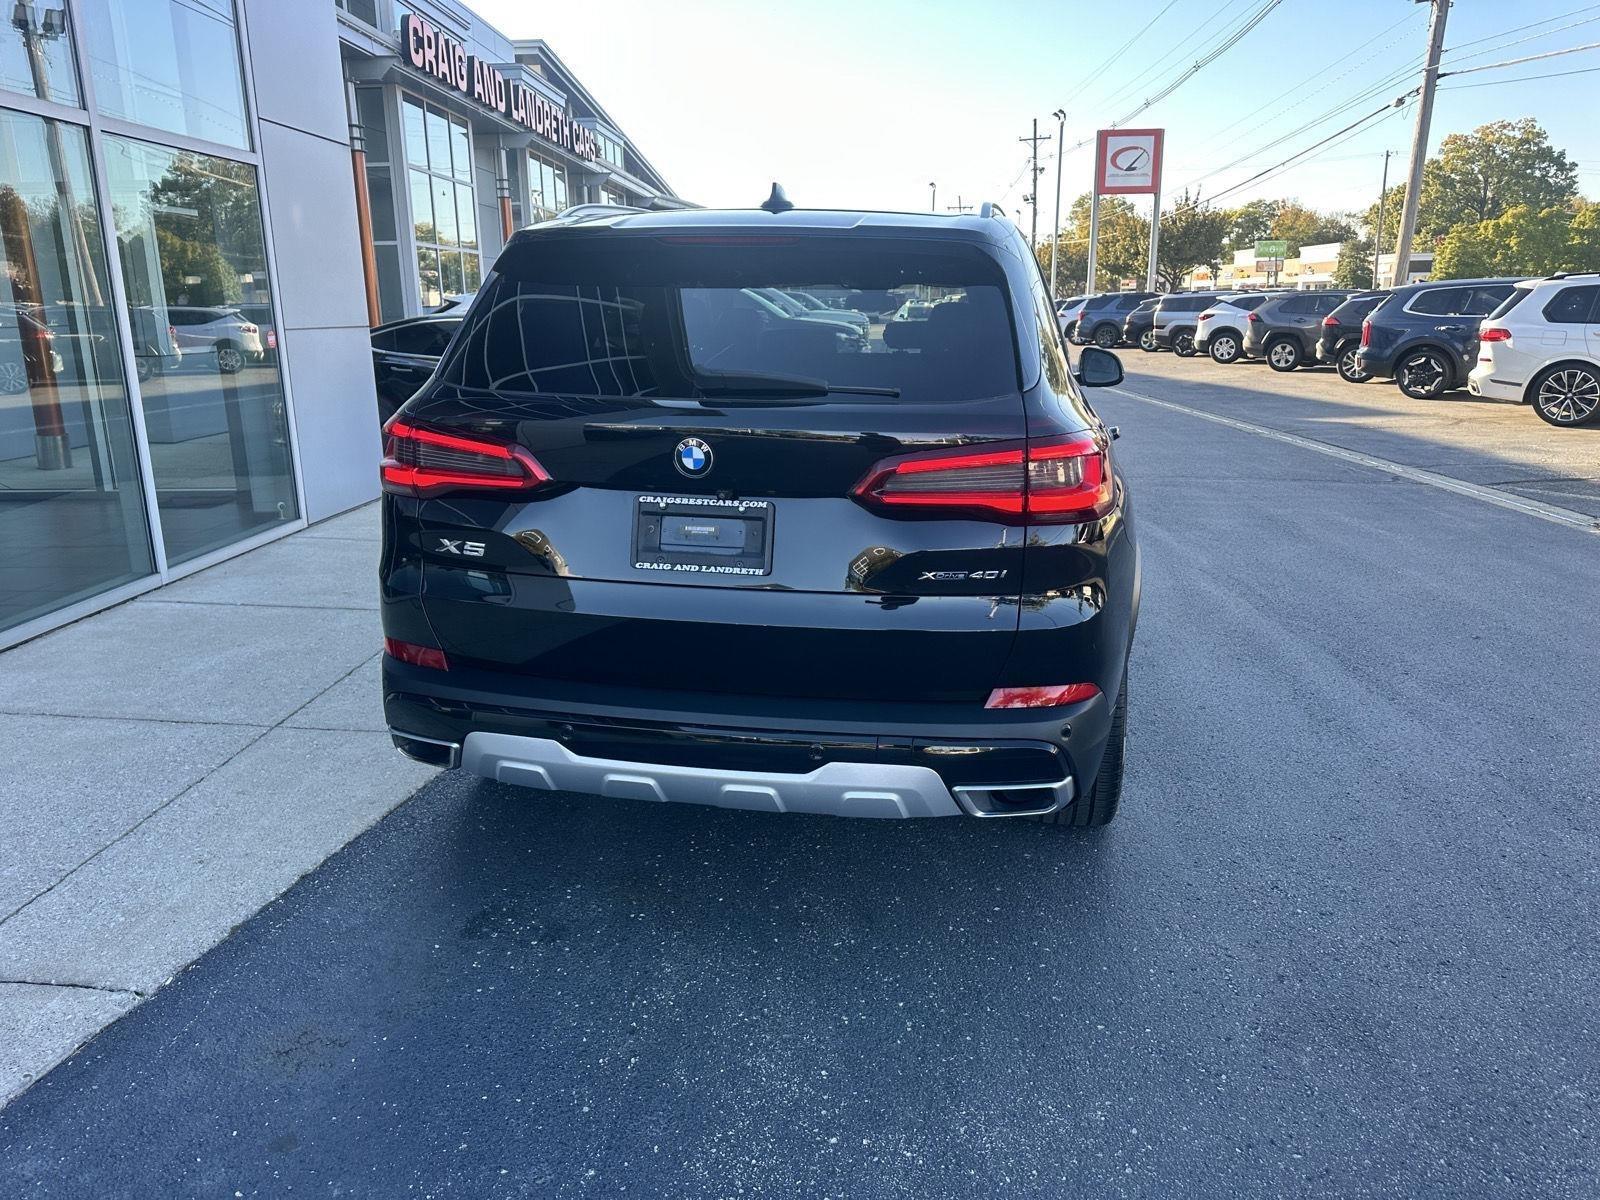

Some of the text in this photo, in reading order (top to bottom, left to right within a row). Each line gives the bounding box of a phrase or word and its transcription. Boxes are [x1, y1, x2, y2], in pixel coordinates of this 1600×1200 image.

[405, 14, 597, 162] CRAIG AND LANDRETH CARS
[678, 439, 709, 453] BMW
[638, 496, 768, 508] CRAIGSBESTCARS.COM
[435, 538, 486, 557] X5
[635, 562, 765, 576] CRAIG AND LANDRETH
